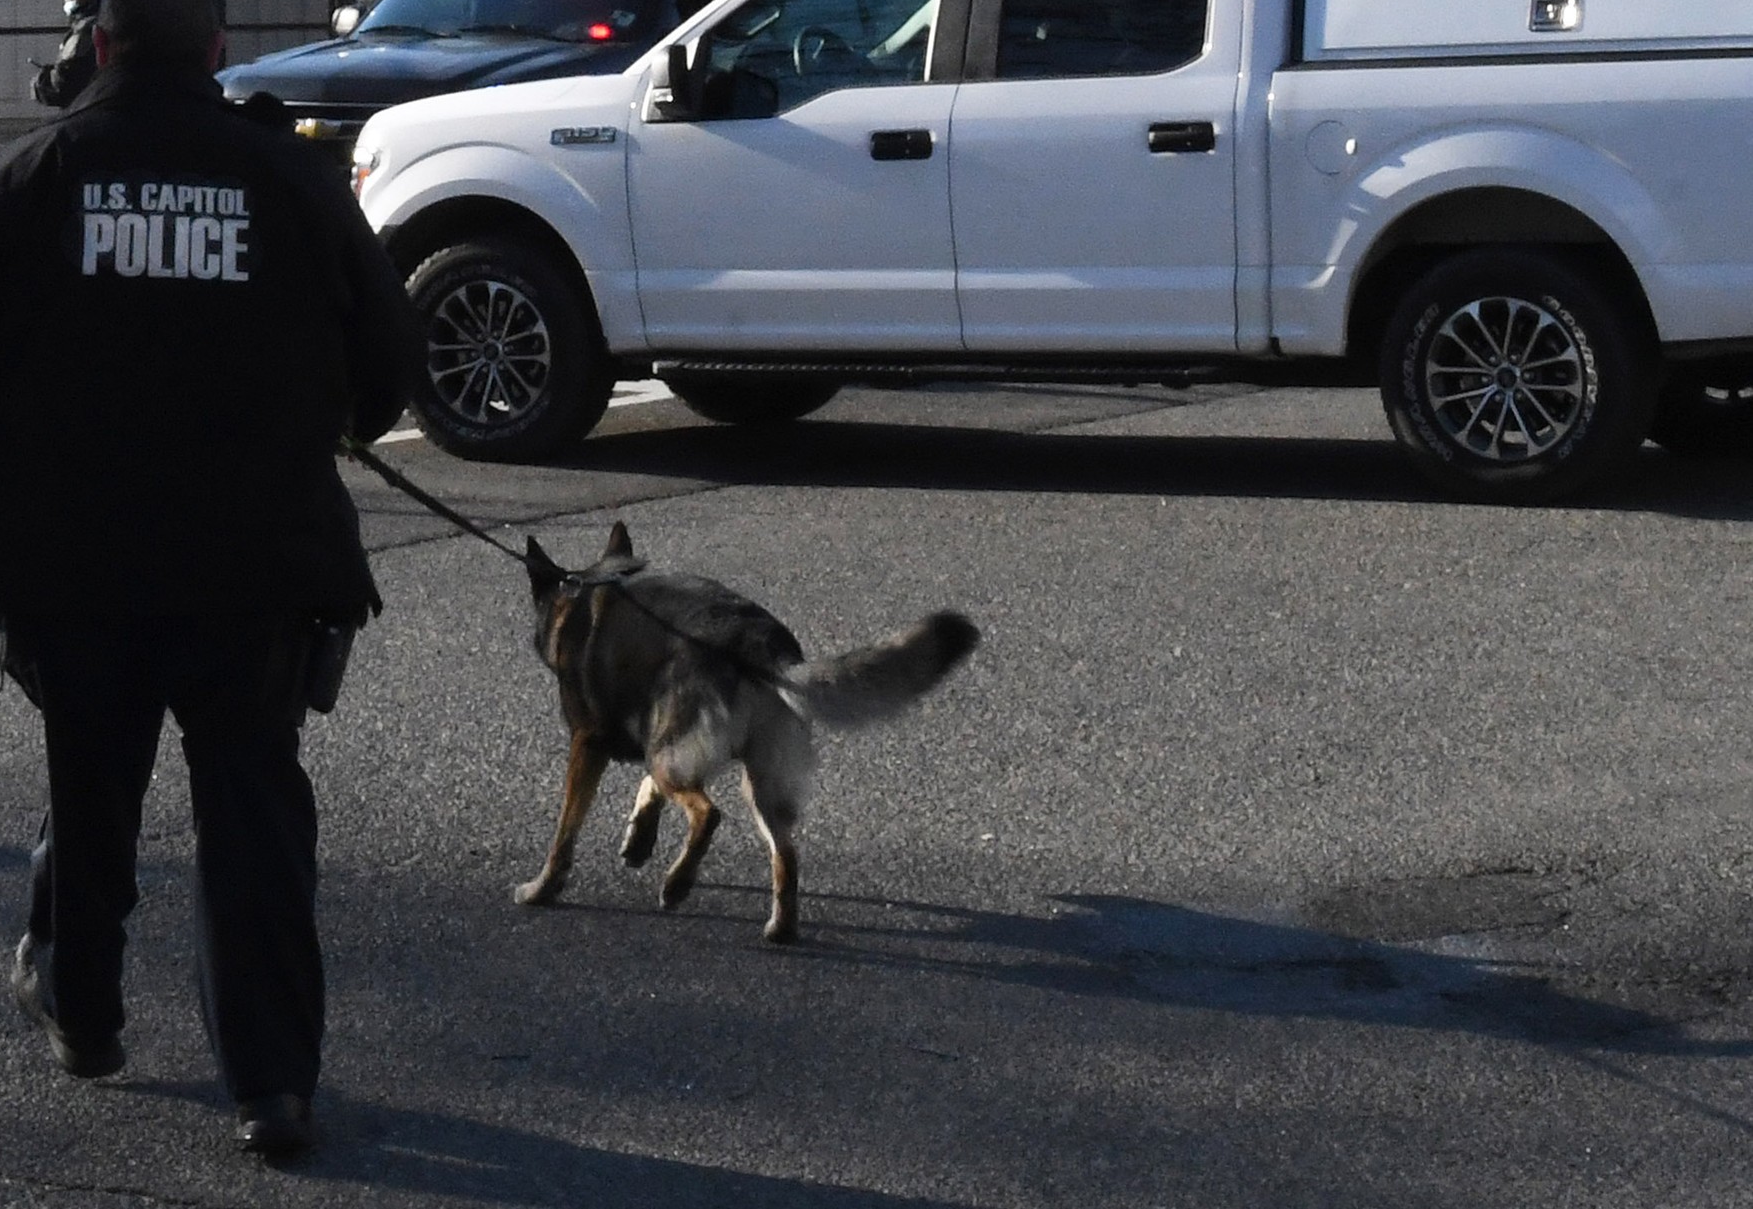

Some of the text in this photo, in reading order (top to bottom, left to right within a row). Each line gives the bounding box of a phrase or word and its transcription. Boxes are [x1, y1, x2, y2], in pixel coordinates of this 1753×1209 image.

[83, 183, 249, 216] U.S. CAPITOL
[82, 213, 249, 281] POLICE
